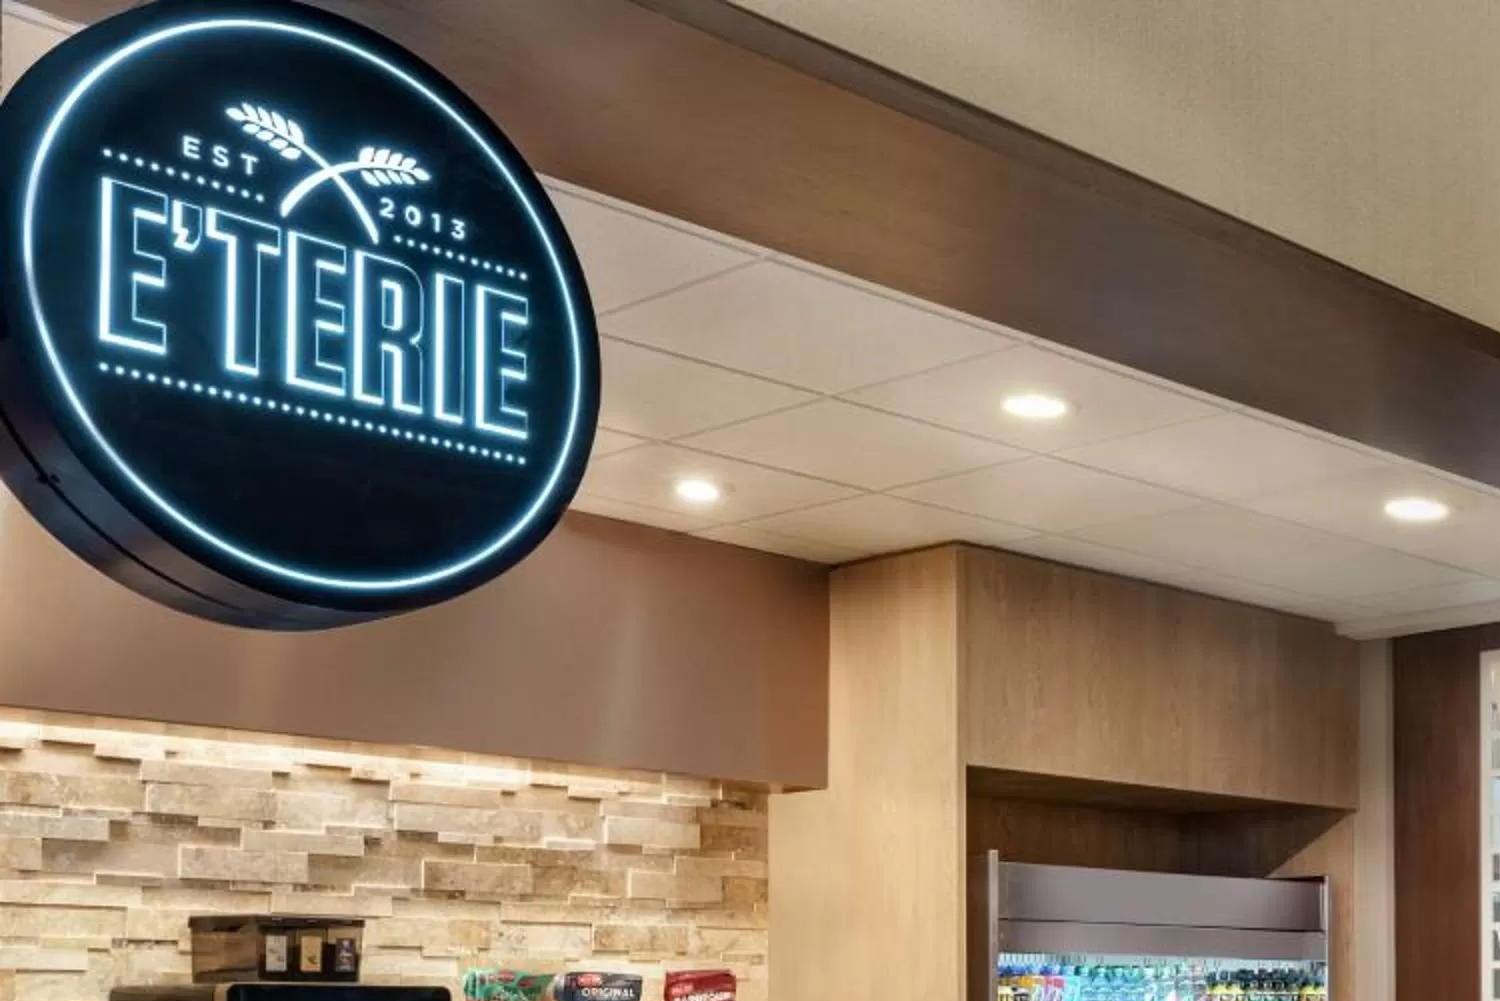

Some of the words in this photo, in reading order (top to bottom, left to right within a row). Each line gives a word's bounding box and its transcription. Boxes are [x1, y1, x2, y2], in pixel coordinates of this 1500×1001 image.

[182, 135, 261, 176] EST
[379, 197, 467, 241] 2013
[99, 176, 529, 439] E'TERIE
[580, 986, 635, 999] ORIGINAL
